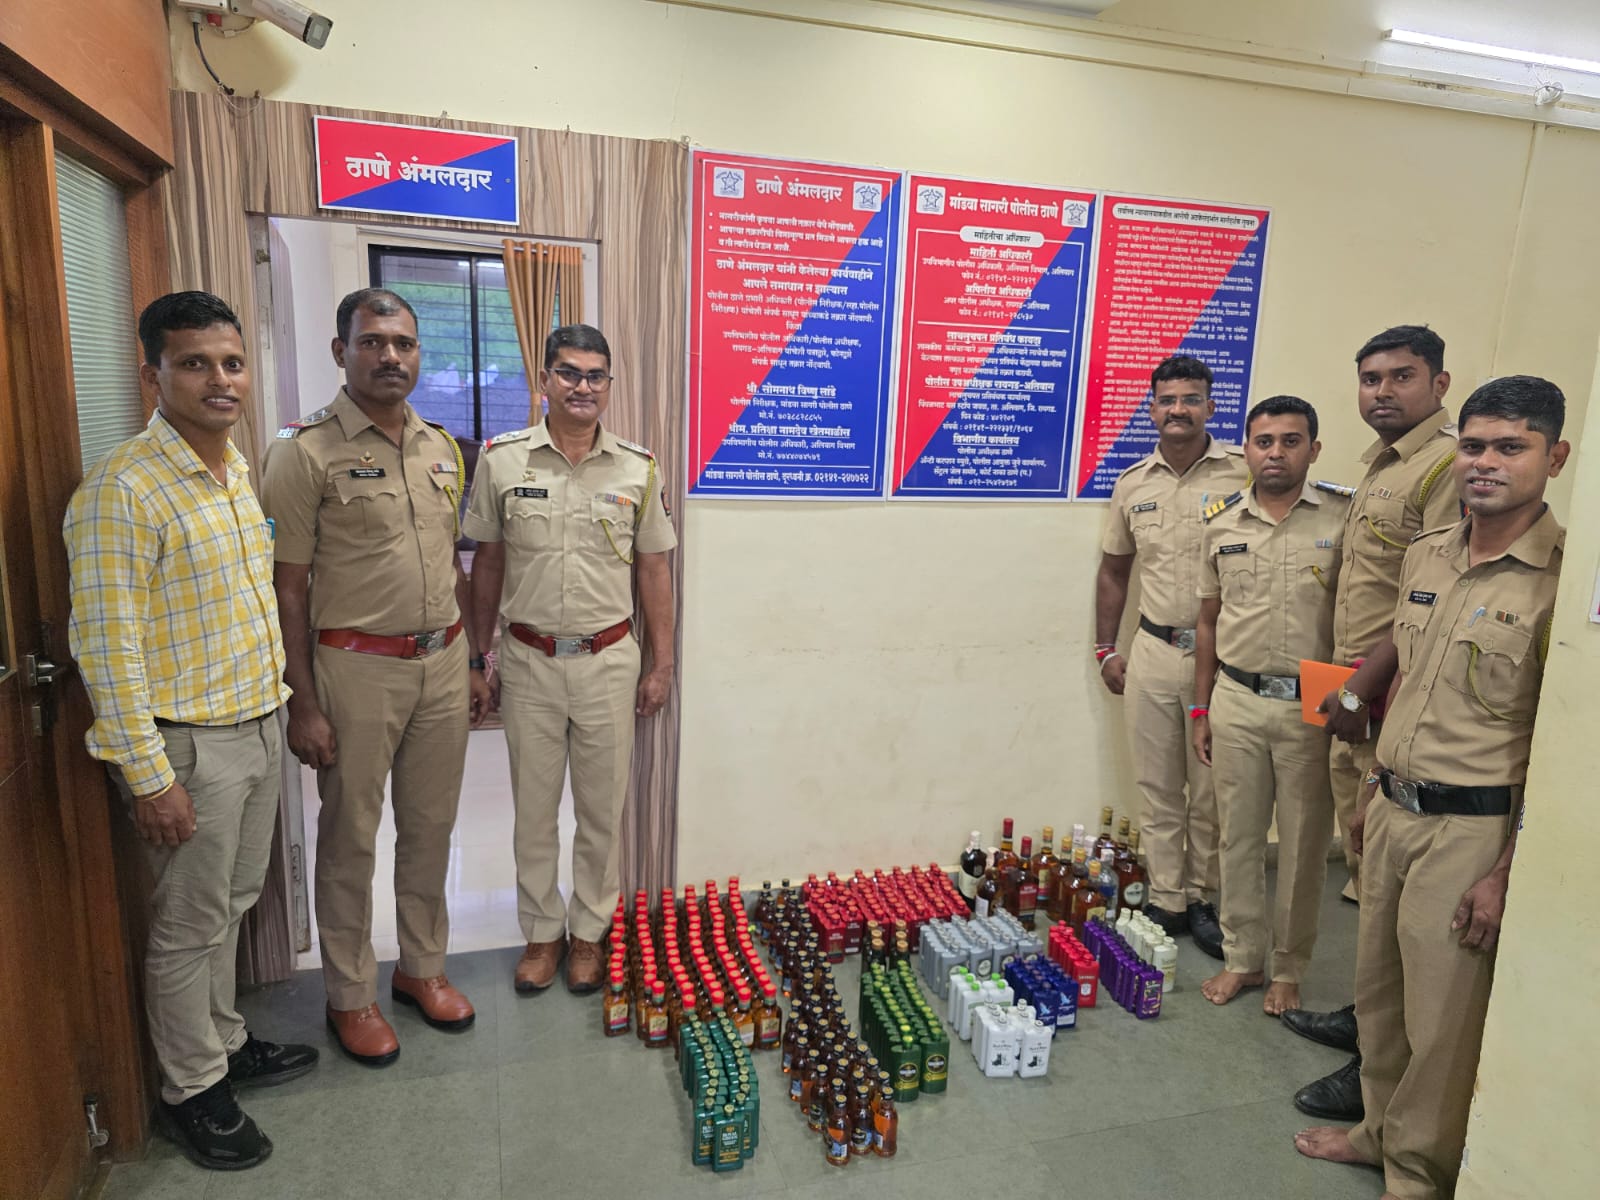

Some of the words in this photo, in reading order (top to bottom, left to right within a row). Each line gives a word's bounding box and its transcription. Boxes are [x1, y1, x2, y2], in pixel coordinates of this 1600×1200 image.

[345, 152, 391, 179] ठाणे
[397, 155, 492, 192] अंमलदार
[949, 192, 978, 210] मांडवा
[980, 197, 1008, 213] सागरी
[1010, 198, 1039, 216] पोलीस
[1040, 201, 1058, 218] ठाणे
